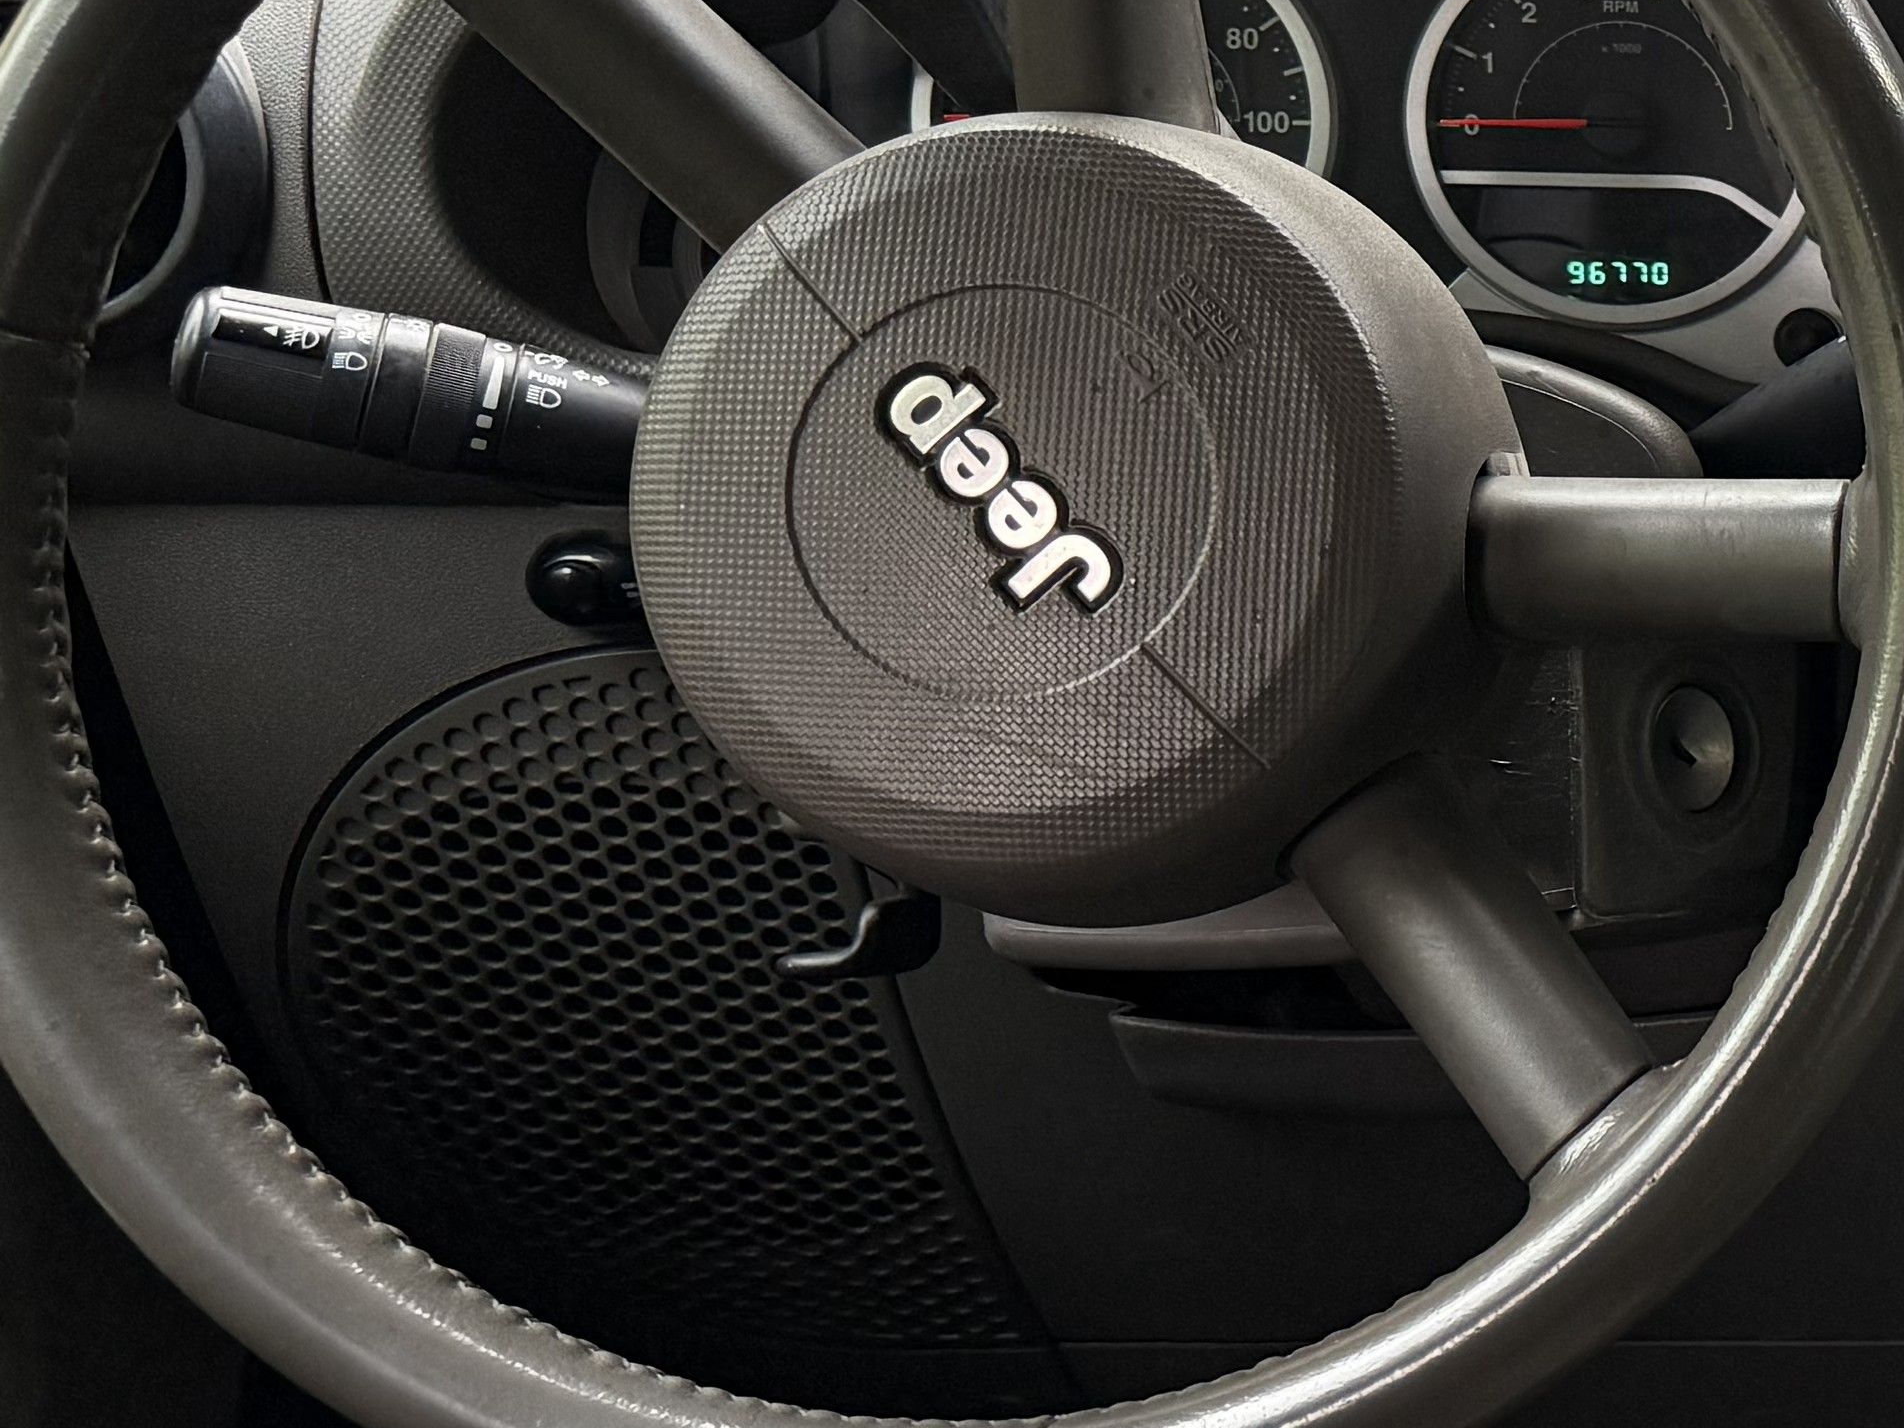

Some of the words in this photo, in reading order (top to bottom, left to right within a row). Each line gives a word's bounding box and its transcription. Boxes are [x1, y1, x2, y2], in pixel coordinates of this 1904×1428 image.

[1521, 2, 1538, 24] 2
[1603, 0, 1640, 13] RPM
[1225, 27, 1260, 51] 80
[1480, 52, 1495, 74] 1
[1242, 110, 1291, 134] 100
[1566, 260, 1669, 286] 96770
[527, 371, 569, 390] PUSH
[888, 373, 1113, 604] Jeep
